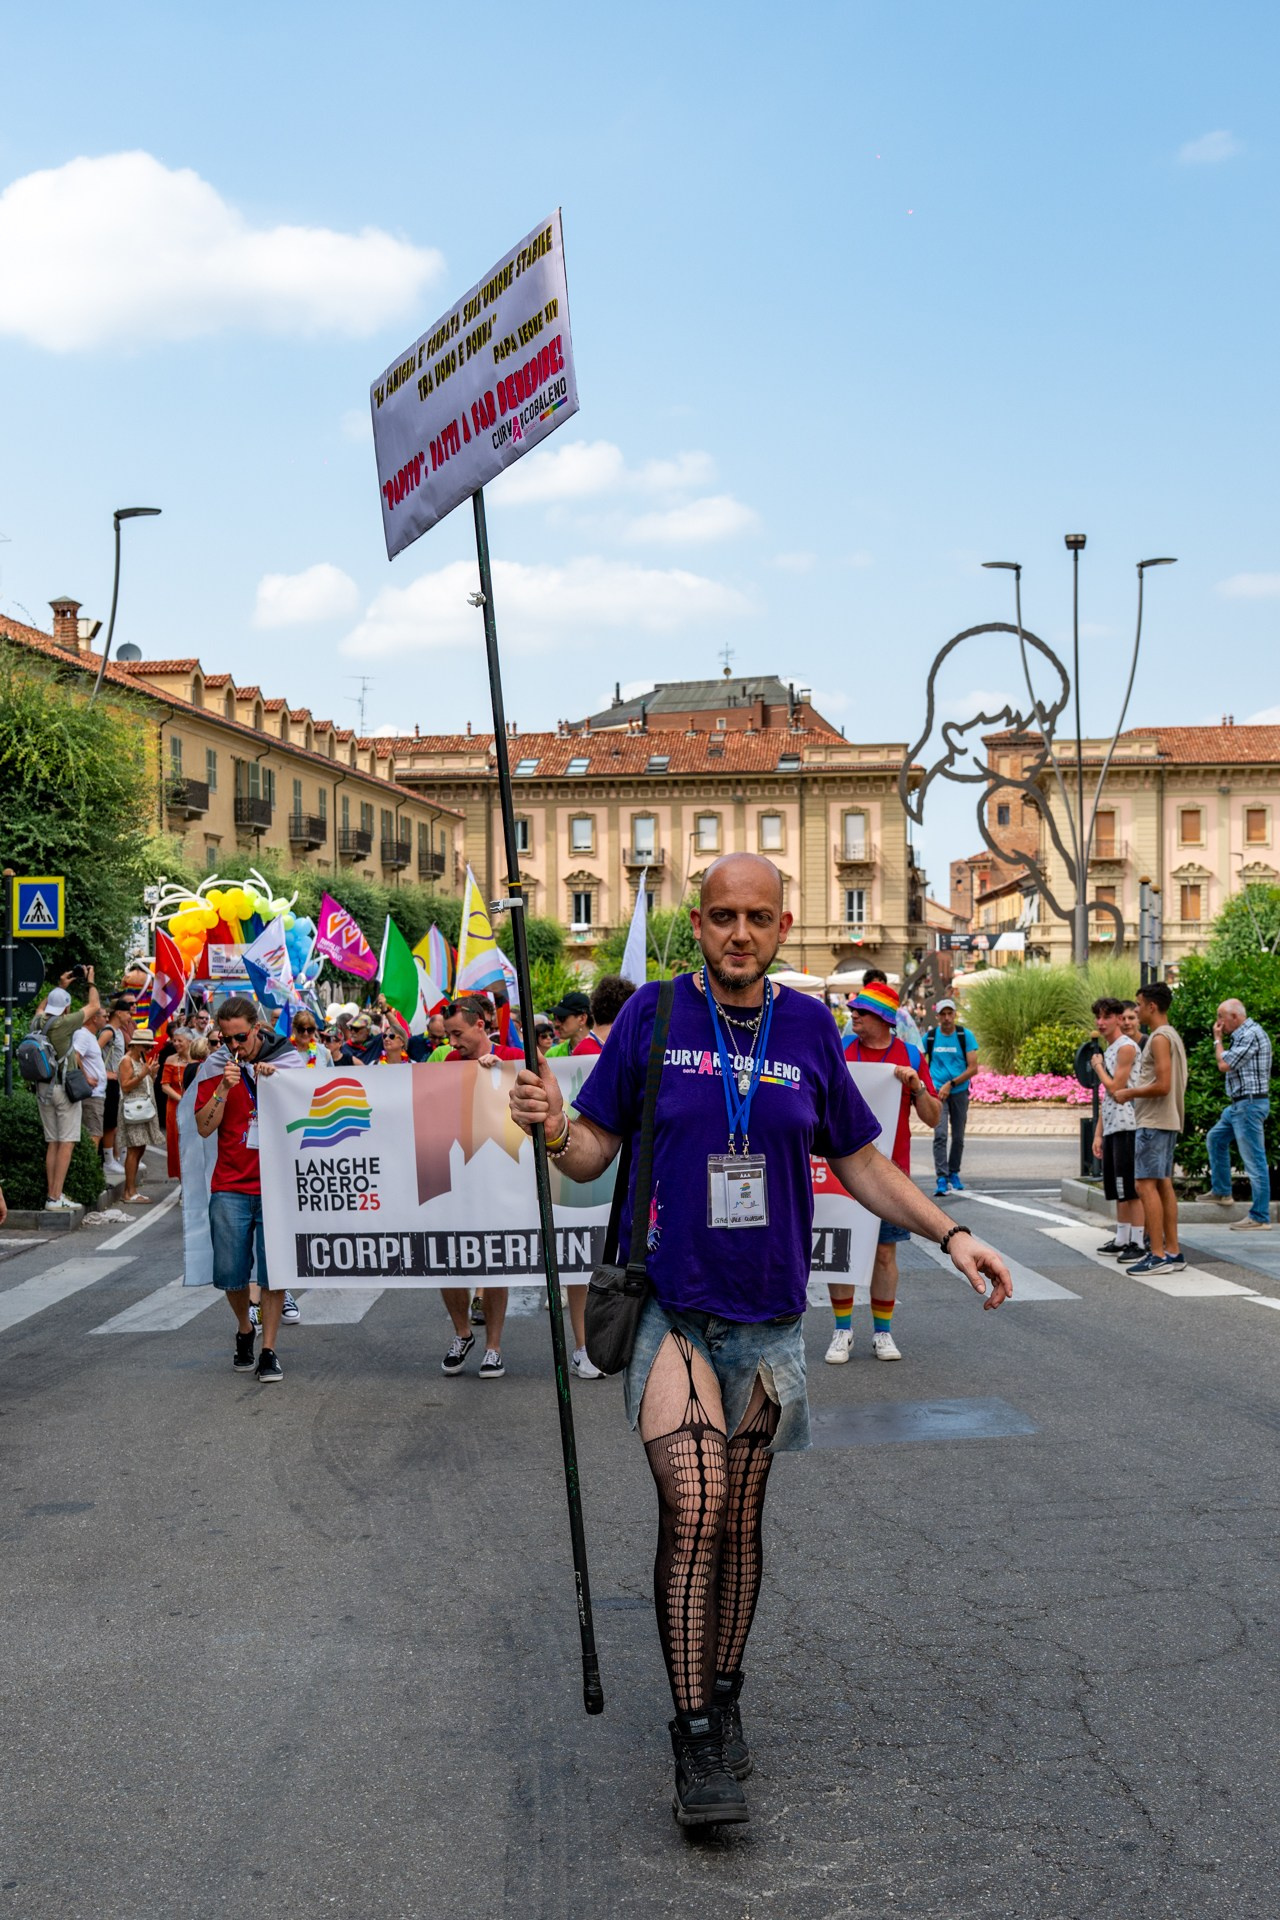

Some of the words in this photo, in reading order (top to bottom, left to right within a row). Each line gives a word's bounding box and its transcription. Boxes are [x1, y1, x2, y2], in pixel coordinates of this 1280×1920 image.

[386, 353, 416, 399] FAMIGLIA
[427, 311, 459, 361] FONDATA
[463, 260, 515, 327] SULL'UNIONE
[516, 224, 553, 278] STABILE
[493, 333, 518, 365] PAPA
[518, 310, 543, 347] LEONE
[544, 298, 559, 324] XIV
[417, 371, 433, 402] TRA
[434, 350, 457, 388] UOMO
[458, 341, 464, 367] E
[466, 313, 497, 361] DONNA"
[462, 411, 472, 444] A
[471, 390, 497, 437] FAR
[496, 334, 565, 417] BENEDIRE!
[295, 1157, 380, 1176] LANGHE
[296, 1175, 377, 1194] ROERO-
[298, 1193, 381, 1211] PRIDE25
[309, 1236, 413, 1270] CORPI
[428, 1233, 539, 1269] LIBERI
[555, 1231, 592, 1266] IN
